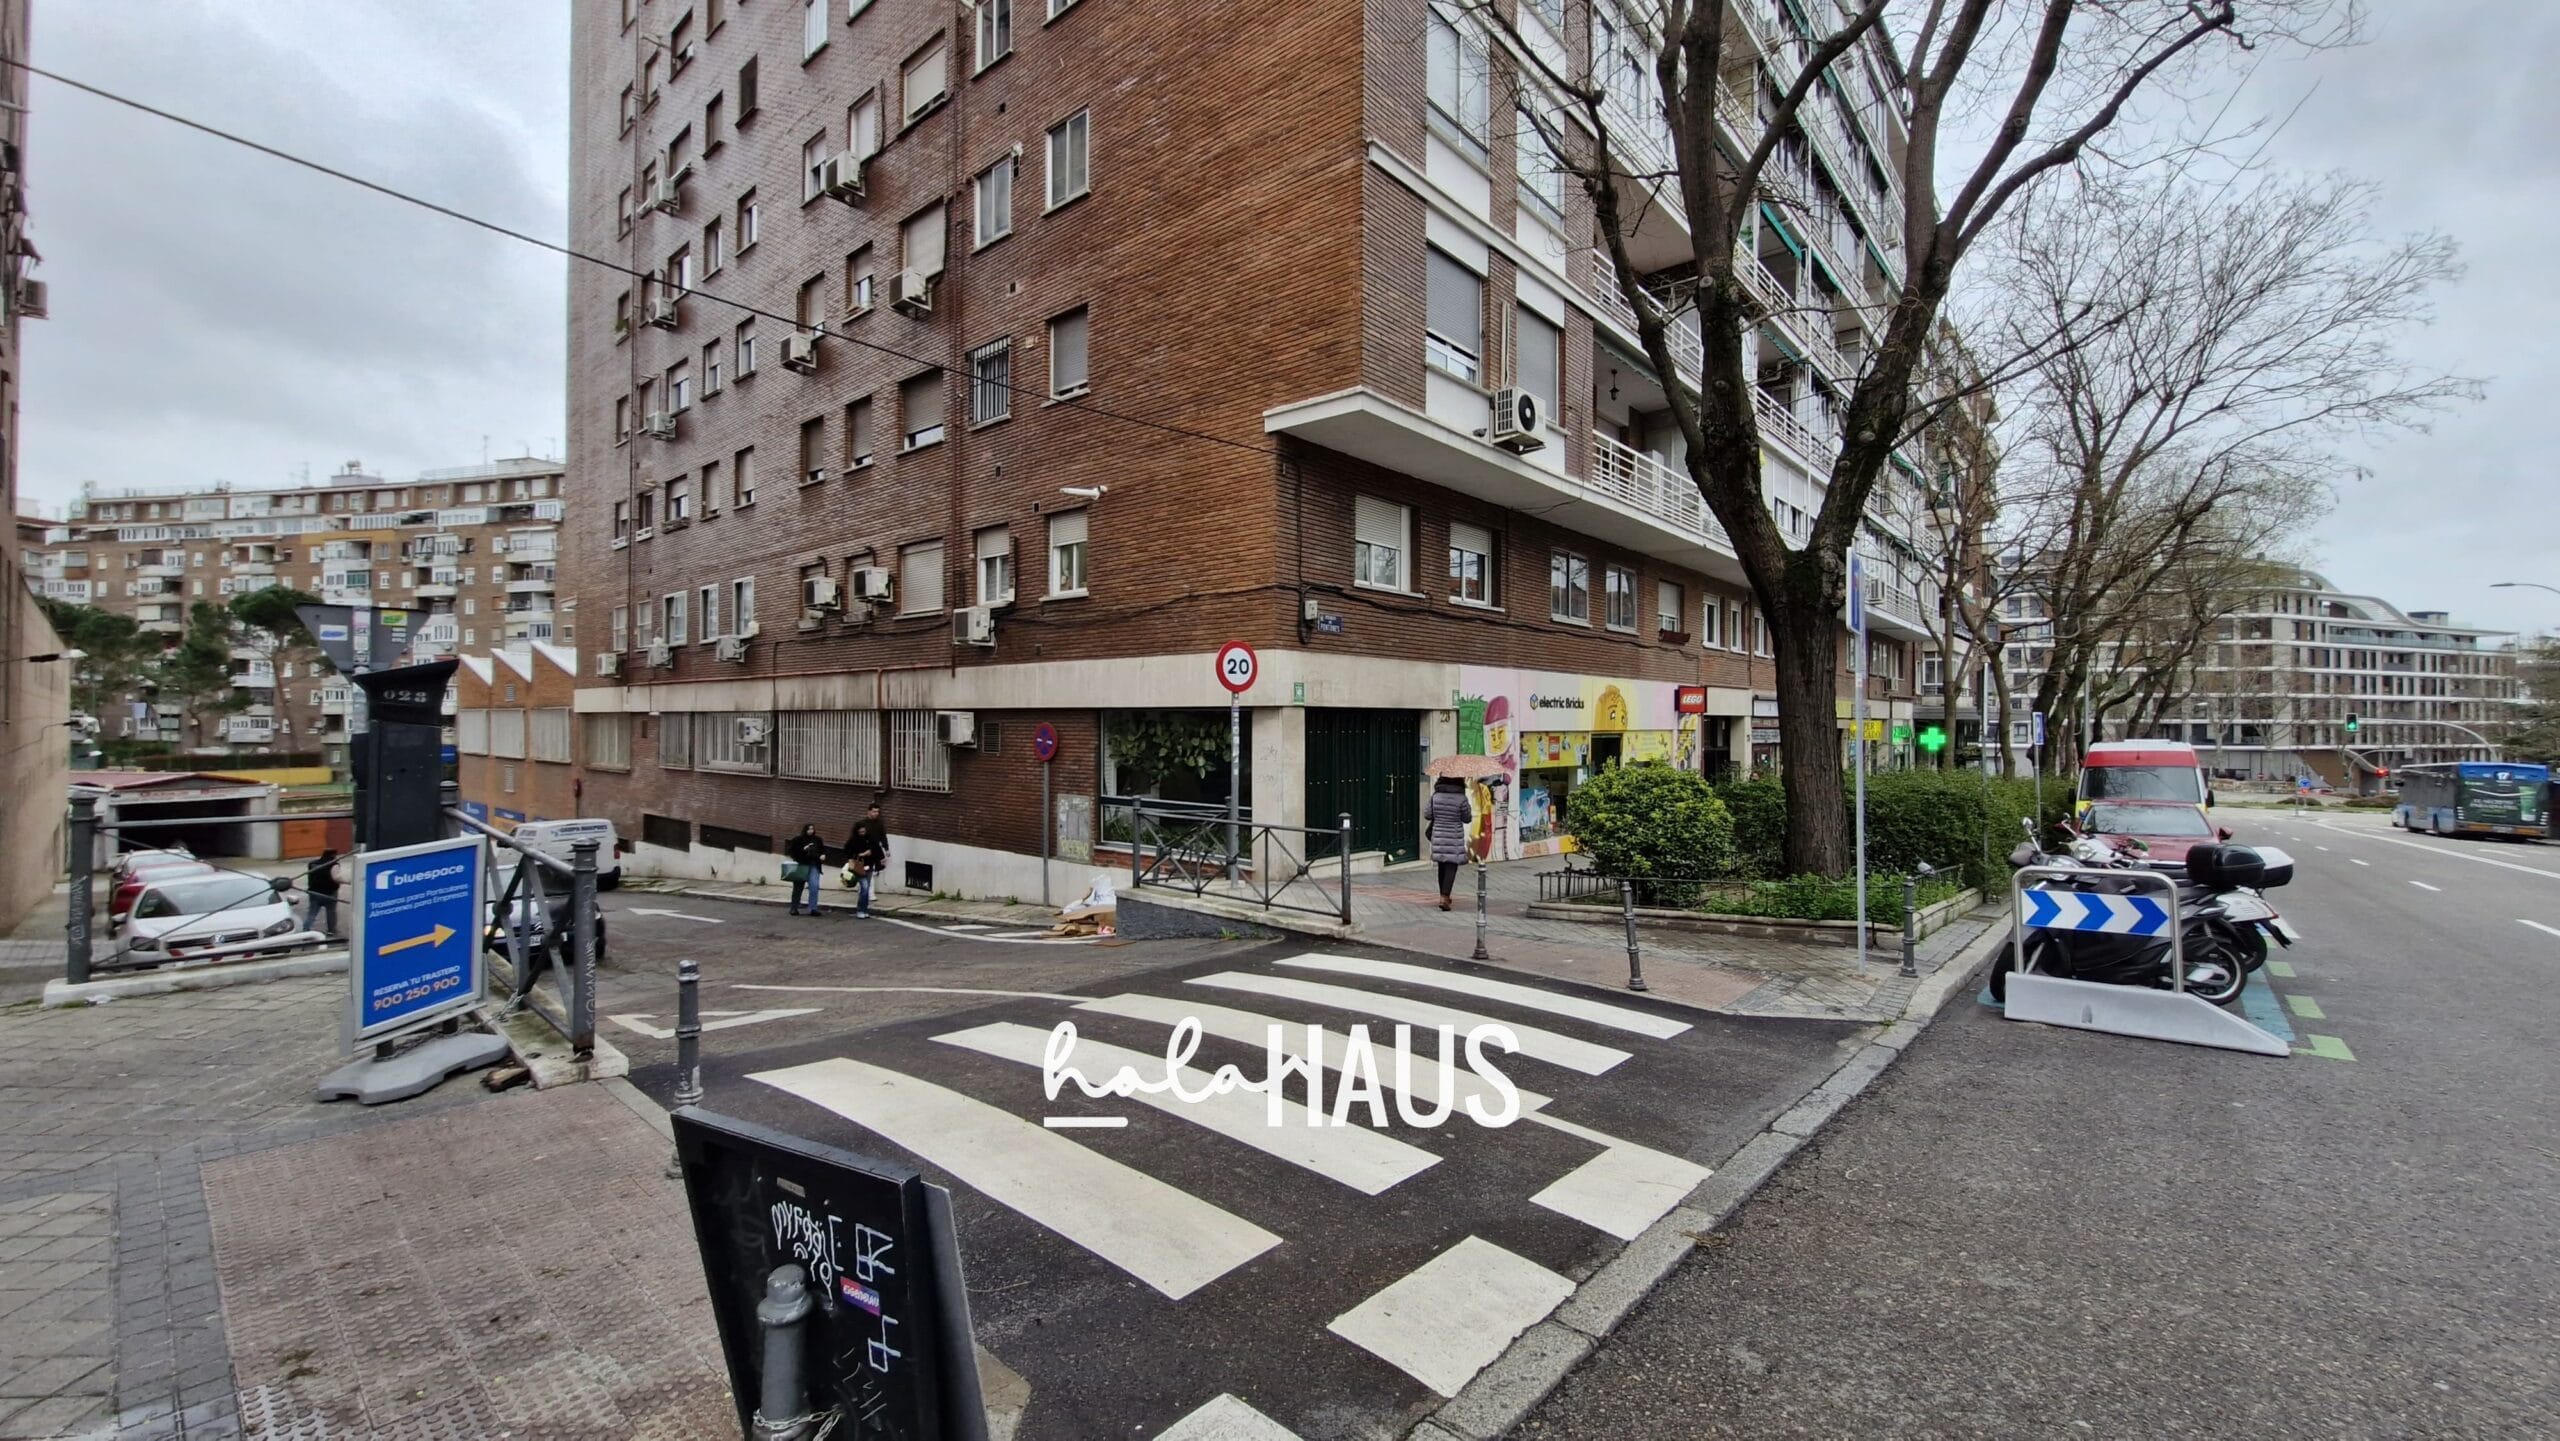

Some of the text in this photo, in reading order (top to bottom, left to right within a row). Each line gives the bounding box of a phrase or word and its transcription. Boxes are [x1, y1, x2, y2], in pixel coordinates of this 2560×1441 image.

[1227, 658, 1249, 675] 20
[1539, 695, 1565, 709] electric
[1682, 694, 1702, 704] LEGO
[394, 864, 465, 886] bluespace
[373, 965, 460, 997] RESERVA TU TRASTERO
[374, 975, 460, 1011] 900 250 900
